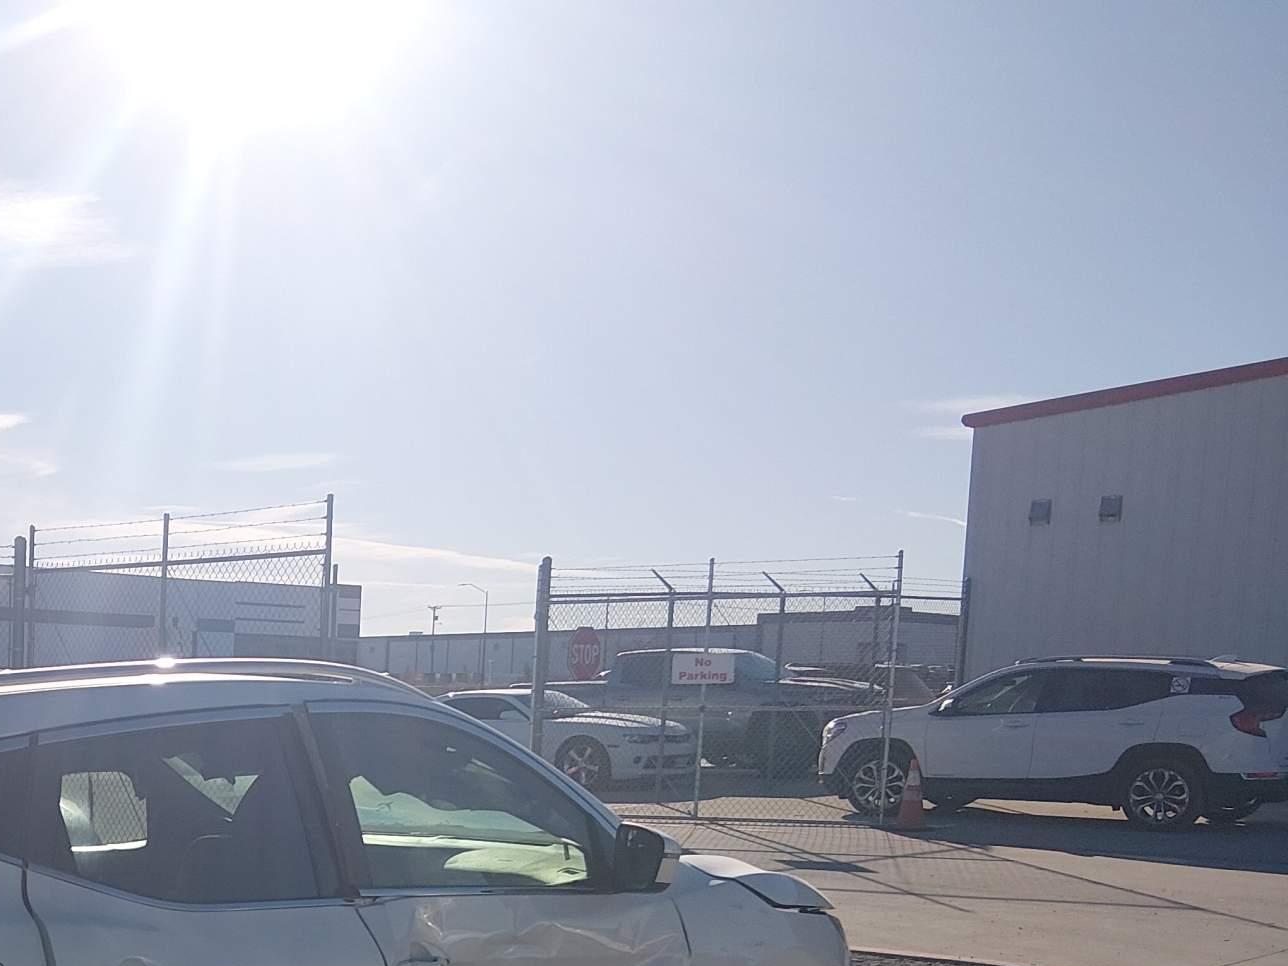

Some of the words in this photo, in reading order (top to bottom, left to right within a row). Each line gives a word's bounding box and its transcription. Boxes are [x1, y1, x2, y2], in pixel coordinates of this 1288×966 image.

[570, 643, 599, 664] STOP
[695, 657, 712, 667] No
[679, 671, 727, 682] Parking
